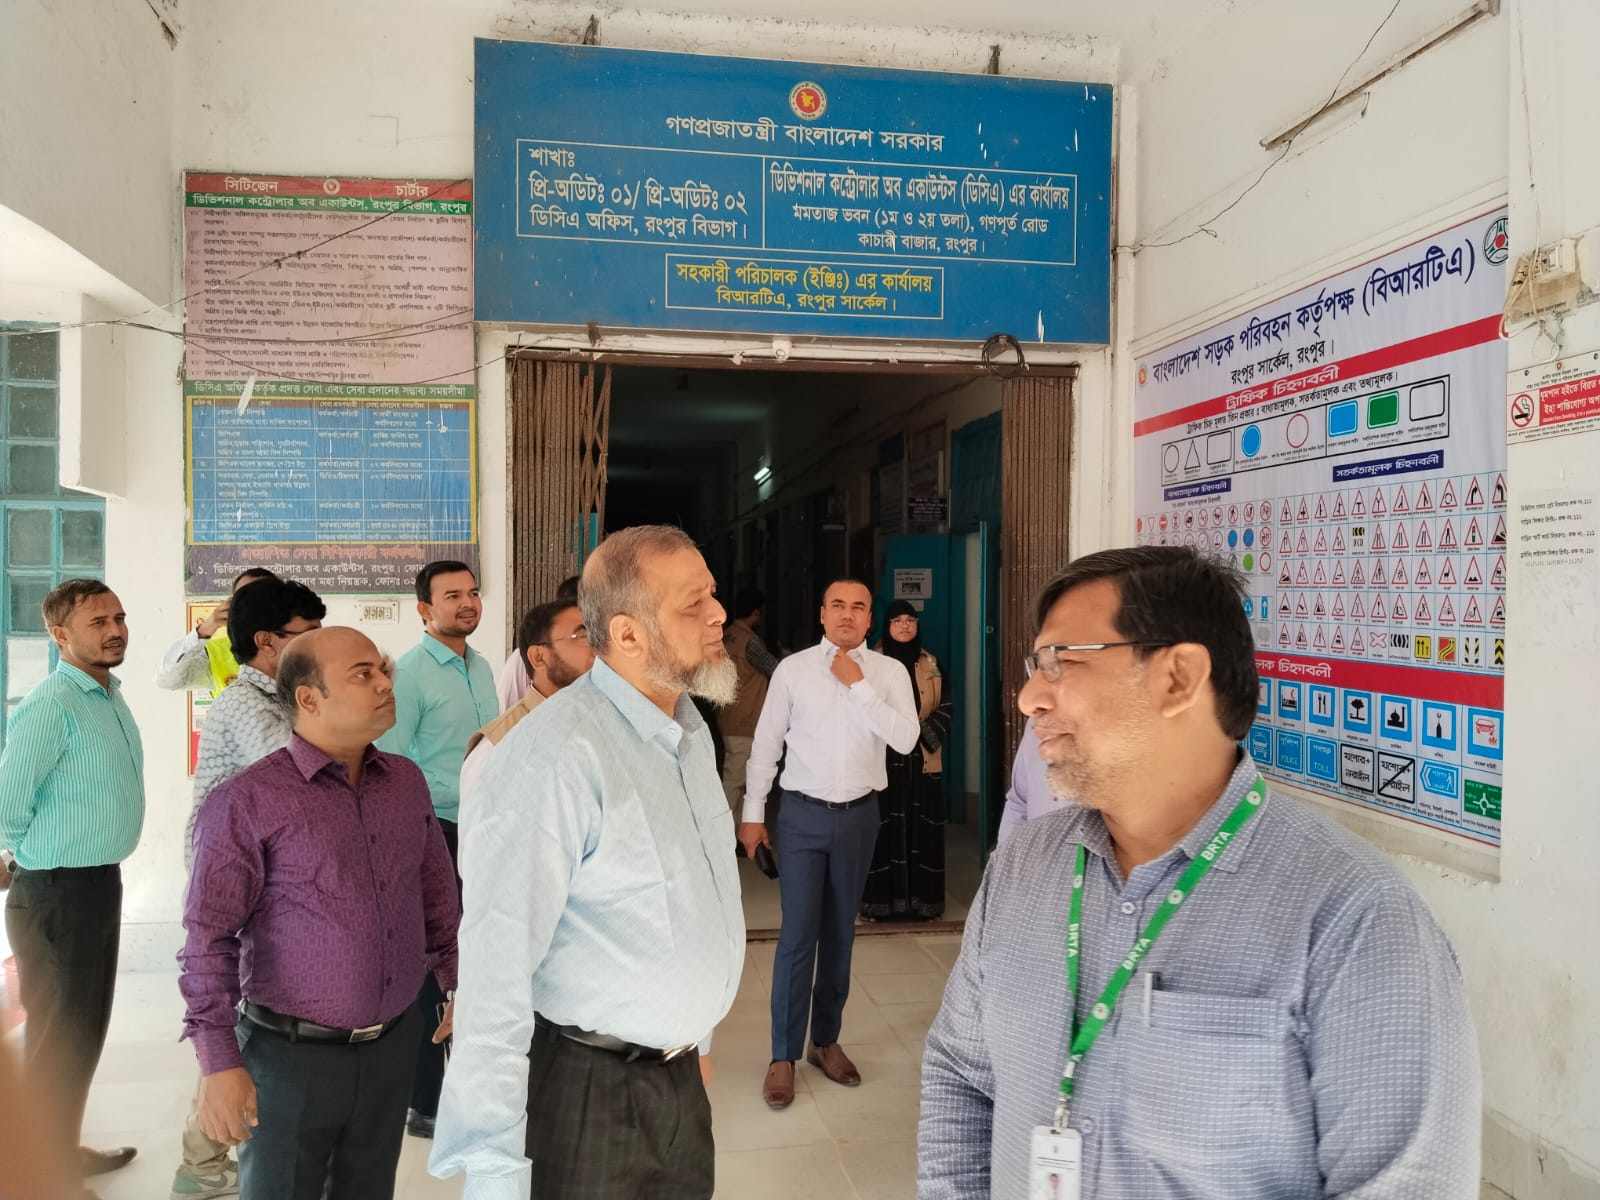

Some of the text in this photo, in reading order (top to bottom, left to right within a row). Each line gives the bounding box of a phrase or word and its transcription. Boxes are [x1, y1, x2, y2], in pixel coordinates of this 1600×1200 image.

[665, 116, 945, 152] গণপ্রজাতন্ত্রী বাংলাদেশ সরকার
[528, 147, 576, 168] শাখাঃ
[224, 176, 429, 197] সিটিজেন চার্টার
[528, 170, 748, 216] প্রি-অডিটঃ ০১/ প্রি-অডিটঃ ০২
[770, 161, 1070, 212] ডিভিশনাল কন্ট্রোলার অব একাউন্টস (ডিসিএ) এর কার্যালয়
[192, 193, 244, 205] ডিভিশনাল
[248, 195, 294, 207] কন্ট্রোলার
[298, 197, 315, 207] অব
[372, 199, 400, 212] রংপুর
[440, 203, 467, 213] রংপুর
[529, 204, 580, 229] ডিসিএ
[586, 208, 639, 237] অফিস,
[644, 216, 687, 238] রংপুর
[692, 213, 737, 239] বিভাগ
[793, 204, 1048, 237] মমতাজ ভবন (১ম ও ২য় তলা), গণপূর্ত রোড
[857, 230, 896, 249] কাচারী
[902, 236, 941, 254] বাজার,
[946, 239, 978, 255] রংপুর
[676, 259, 933, 293] সহকারী পরিচালক (ইঞ্জিঃ) এর কার্যালয়
[716, 285, 791, 309] বিআরটিএ,
[796, 292, 836, 312] রংপুর
[840, 291, 887, 311] সার্কেল
[1153, 238, 1476, 384] বাংলাদেশ সড়ক পরিবহন কর্তৃপক্ষ (বিআরটিএ)
[1230, 364, 1256, 385] রংপুর
[1257, 349, 1293, 376] সার্কেল,
[1297, 339, 1326, 365] রংপুর
[195, 381, 221, 392] ডিসিএ
[303, 385, 323, 394] সেবা
[325, 385, 343, 394] এবং
[346, 386, 365, 394] সেবা
[368, 386, 399, 395] প্রদানের
[429, 384, 466, 396] সময়সীমা
[1225, 386, 1269, 411] ট্রাফিক
[1341, 380, 1357, 393] এবং
[1561, 383, 1579, 395] হইতে
[1580, 380, 1597, 392] বিরত
[1335, 462, 1393, 478] সতর্কতামূলক
[213, 563, 259, 574] ডিভিশন
[304, 565, 319, 573] অব
[370, 565, 395, 575] রংপুর
[1201, 830, 1232, 861] BRTA
[1067, 923, 1079, 958] BRTA
[1121, 938, 1152, 970] BRTA
